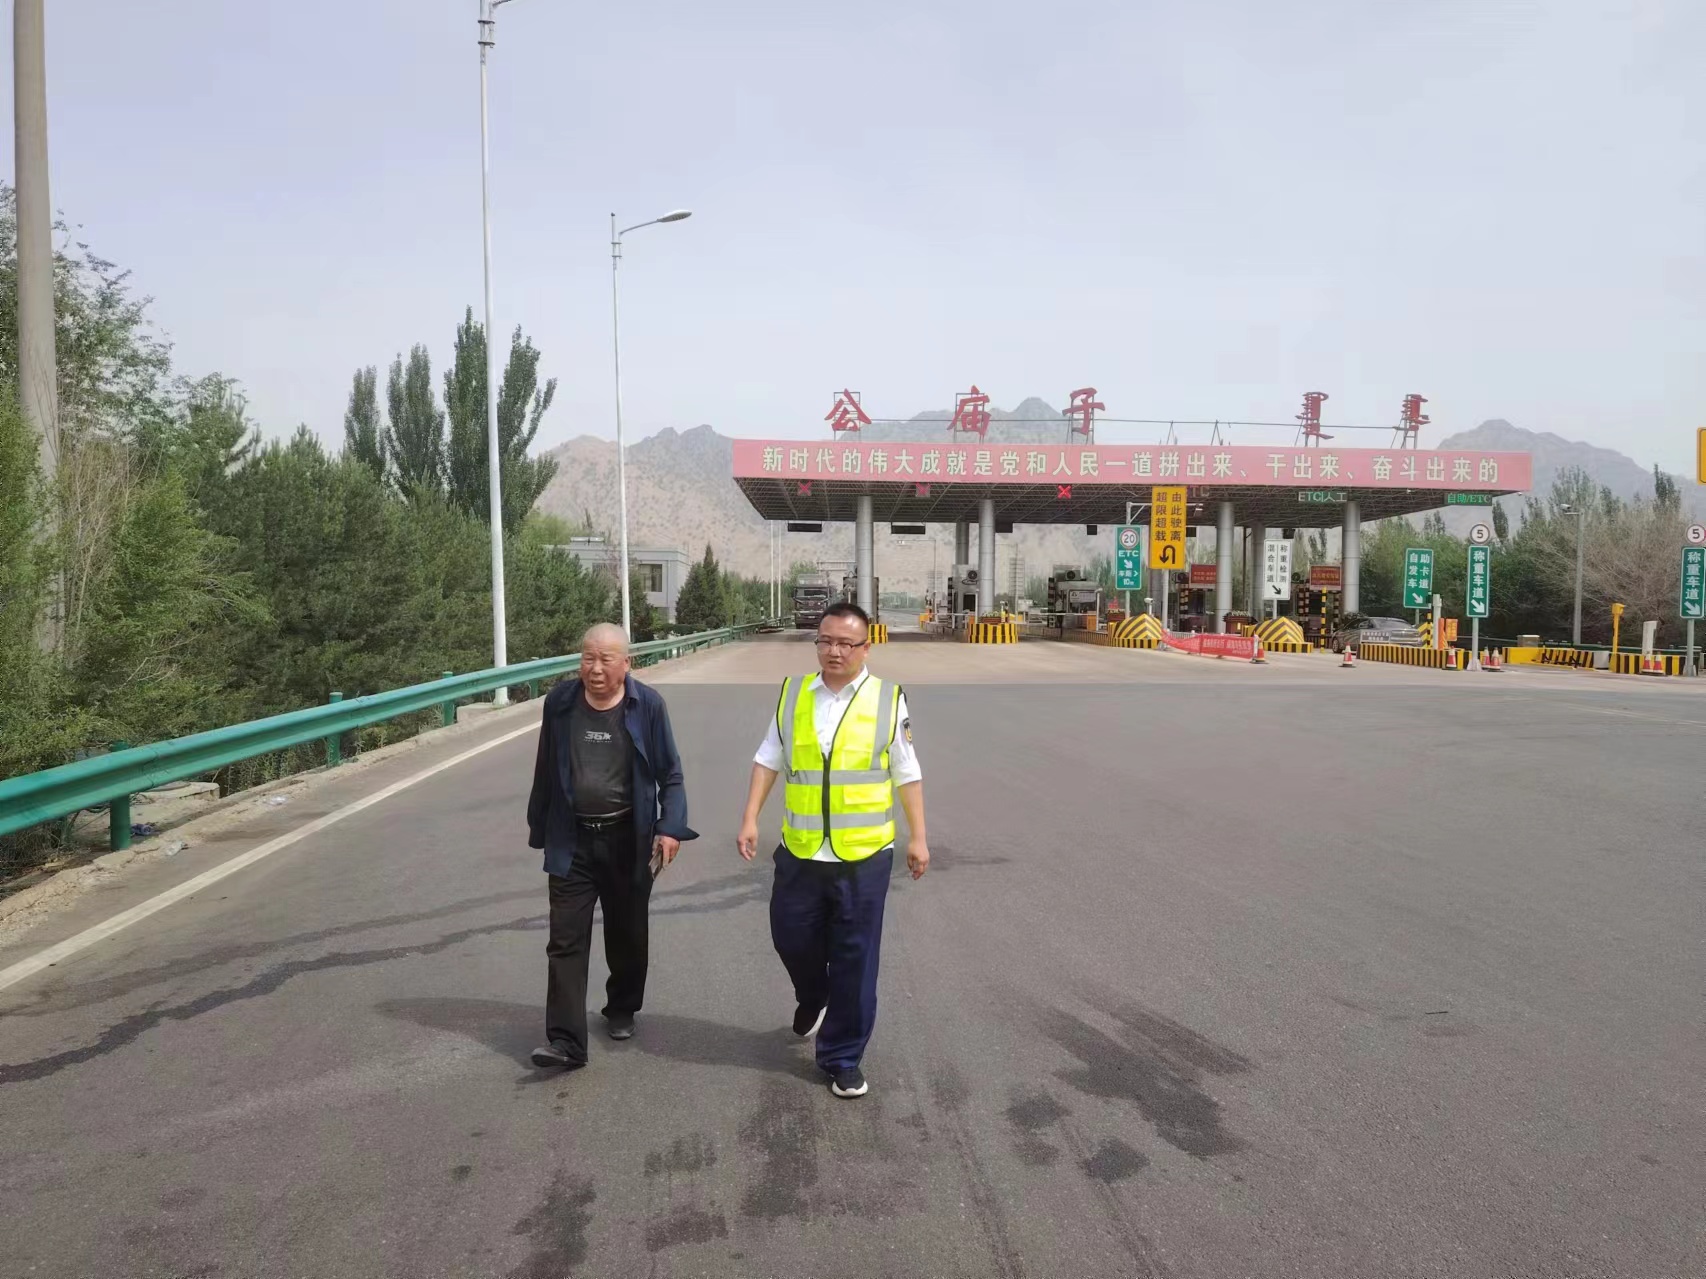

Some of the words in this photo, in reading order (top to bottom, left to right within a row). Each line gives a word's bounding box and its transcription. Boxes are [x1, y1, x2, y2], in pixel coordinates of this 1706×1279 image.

[825, 385, 1105, 436] 公庙子
[762, 445, 1499, 483] 新时代的伟大成就是党和人民一道拼出来、干出来、奋斗出来的
[1155, 492, 1167, 541] 超限超载
[1170, 492, 1182, 541] 由此驶离
[1124, 534, 1136, 544] 20
[1476, 529, 1484, 539] 5
[1692, 528, 1700, 539] 5
[1408, 565, 1430, 576] 发卡
[1409, 553, 1430, 564] 自助
[1407, 578, 1429, 589] 车道
[1472, 550, 1485, 599] 称重车道
[1685, 551, 1701, 600] 称重车道
